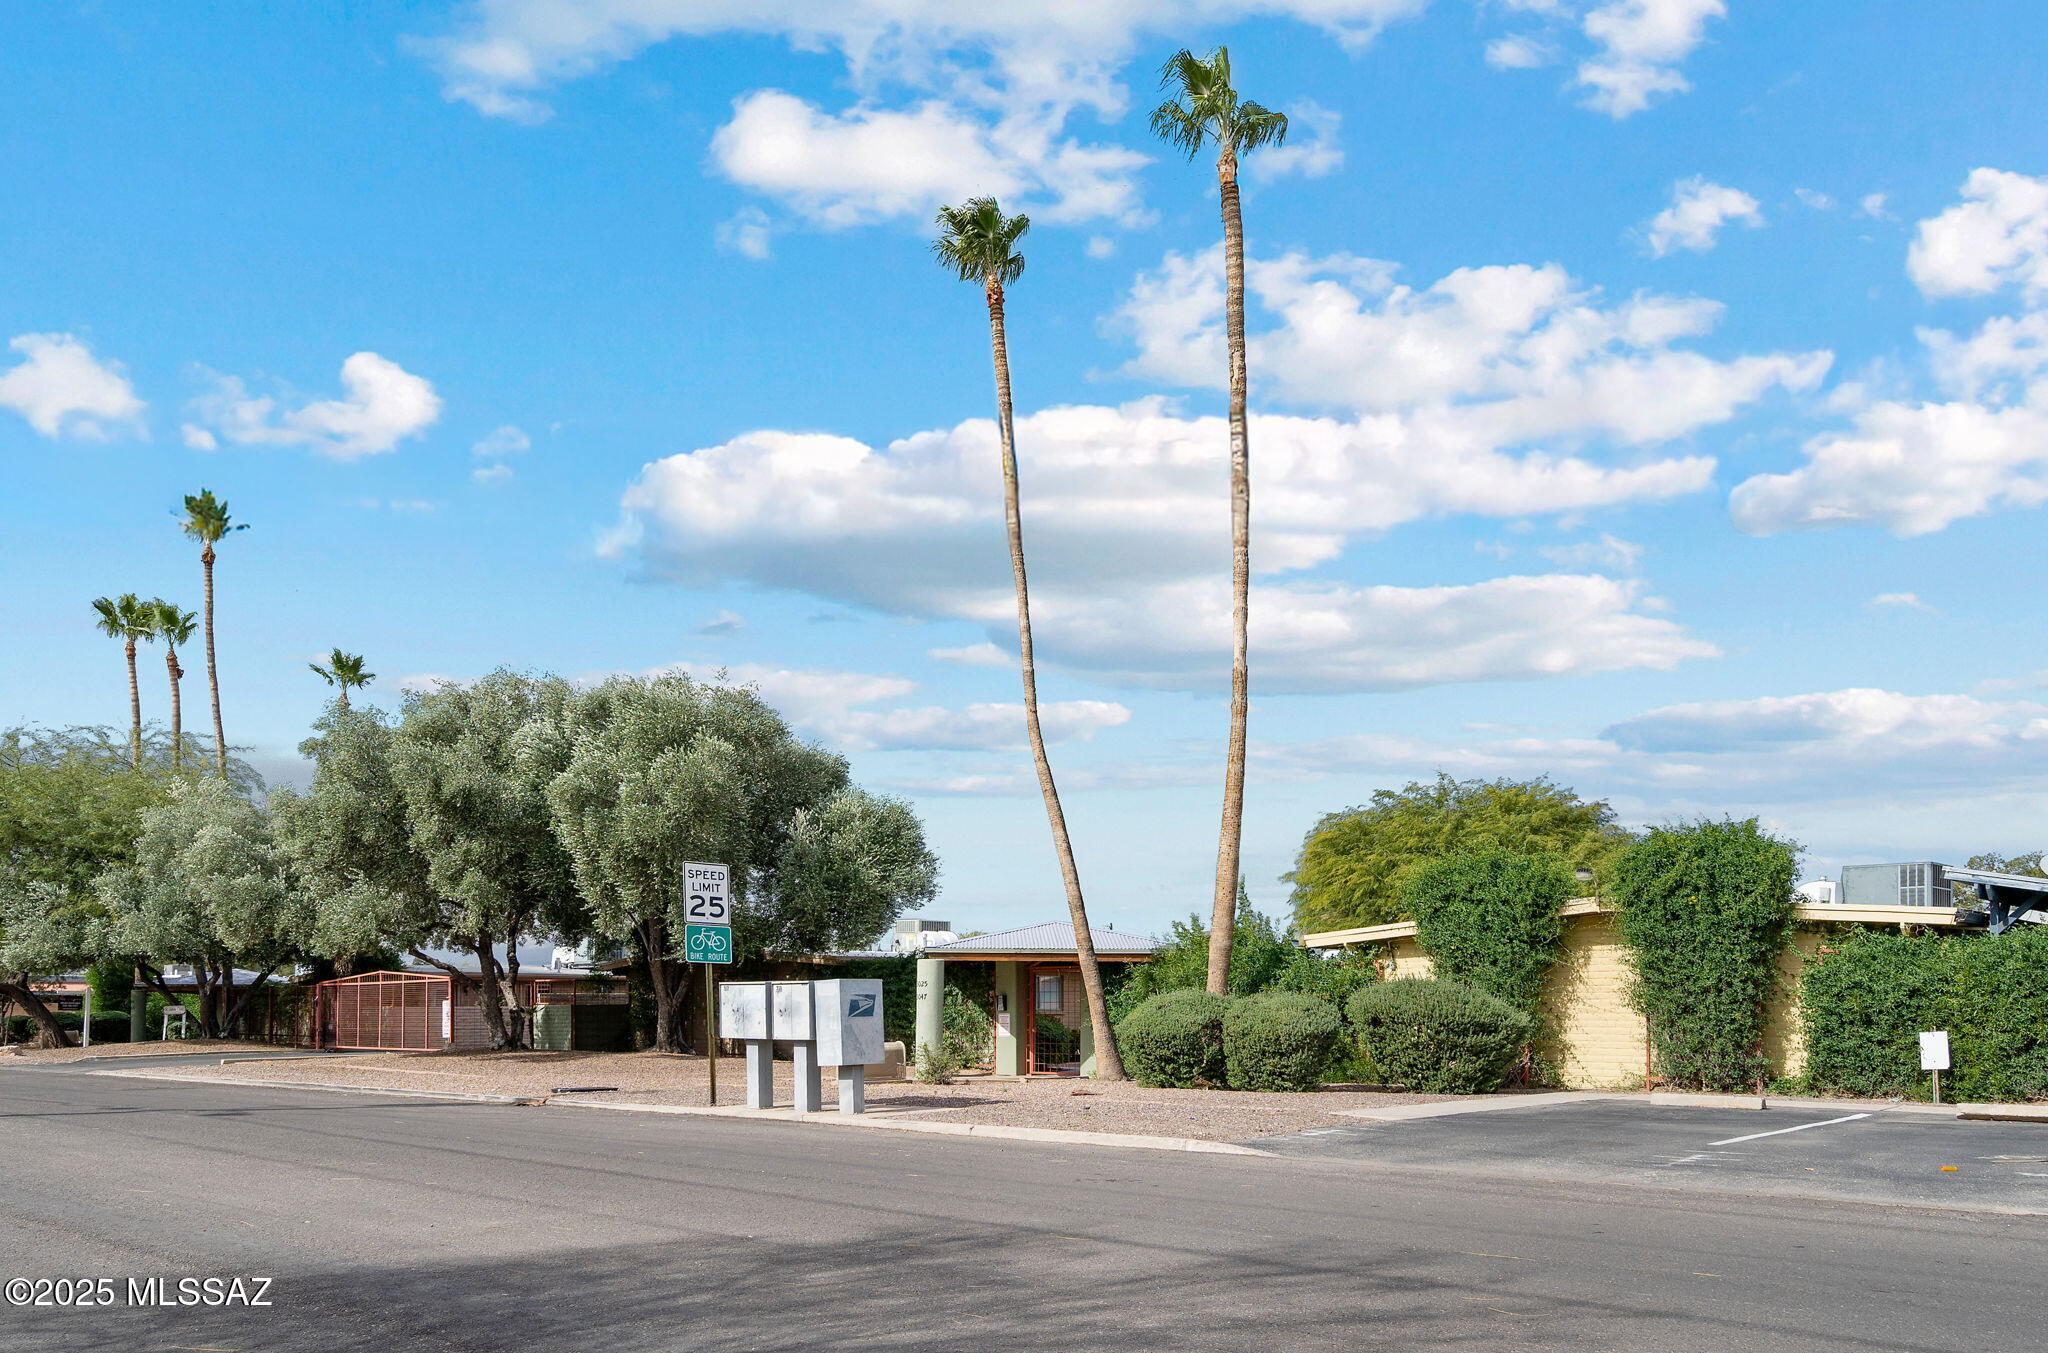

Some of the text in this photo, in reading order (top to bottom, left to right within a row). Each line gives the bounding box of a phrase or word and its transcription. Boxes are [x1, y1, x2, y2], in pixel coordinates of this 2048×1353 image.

[688, 869, 725, 881] SPEED
[692, 882, 721, 892] LIMIT
[689, 894, 725, 918] 25
[690, 952, 728, 961] BIKE ROUTE
